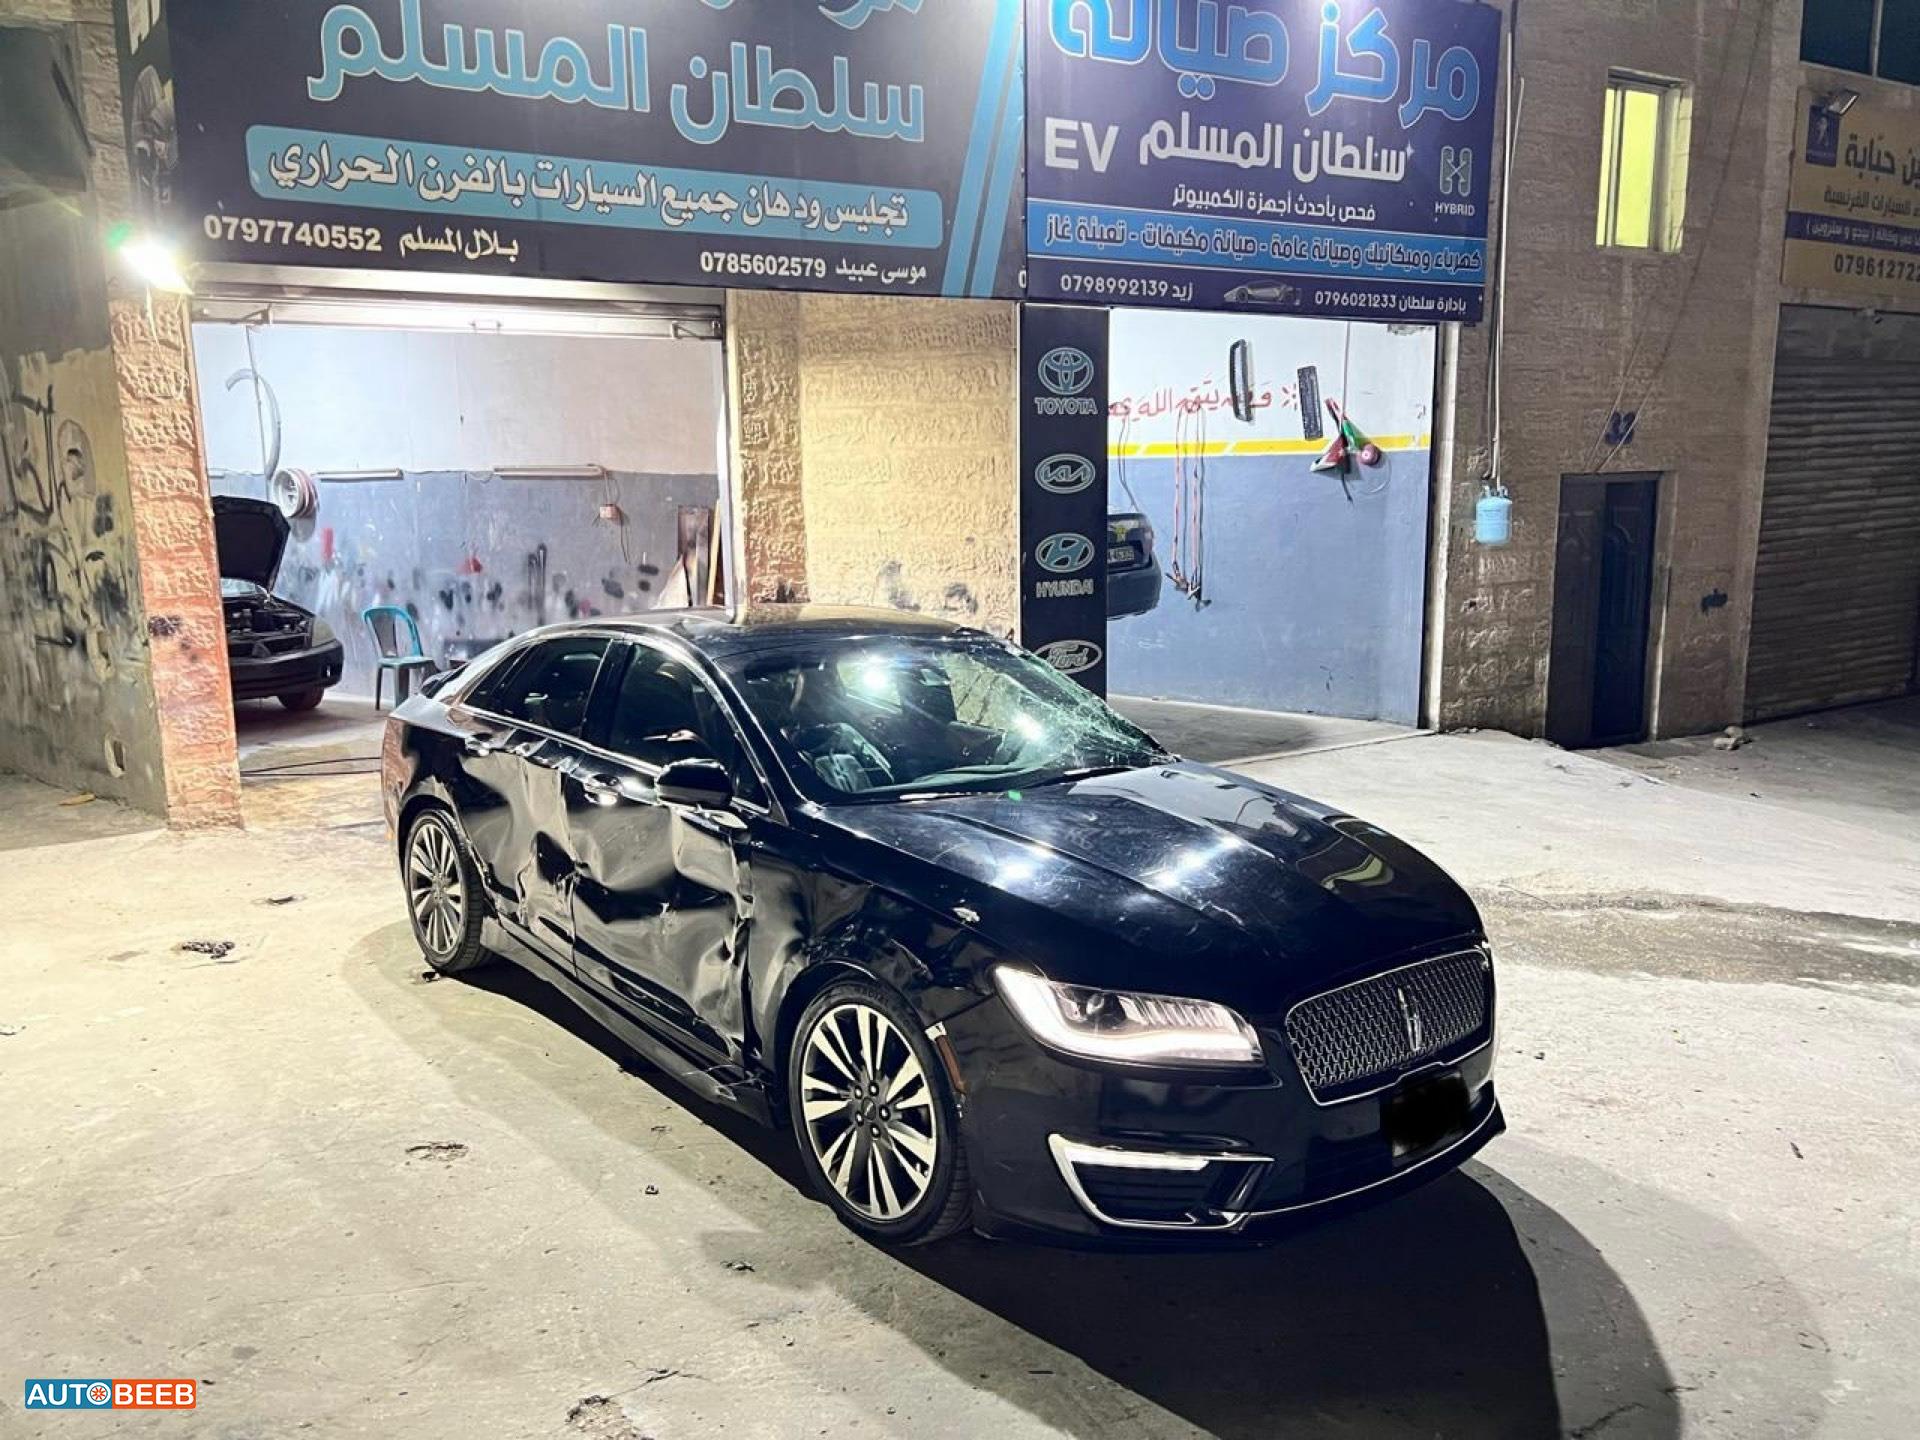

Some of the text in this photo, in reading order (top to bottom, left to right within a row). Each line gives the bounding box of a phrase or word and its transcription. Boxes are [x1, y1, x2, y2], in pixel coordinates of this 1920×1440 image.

[307, 0, 925, 145] سلطان المسلم
[1305, 0, 1480, 129] مركز
[1044, 116, 1119, 172] EV
[1139, 111, 1406, 183] سلطان المسلم
[269, 141, 909, 239] تجليس ودهان جميع السيارات بالفرن الحراري
[1172, 183, 1245, 211] الكمبيوتر
[1338, 204, 1376, 223] فحص
[1434, 201, 1476, 217] HYBRID
[203, 215, 382, 252] 0797740552
[399, 225, 463, 258] المسلم
[1044, 212, 1072, 247] غاز
[1076, 215, 1128, 250] تعبئة
[1141, 221, 1210, 256] مكيفات
[1212, 227, 1258, 261] صيانة
[1271, 233, 1309, 261] عامة
[700, 251, 927, 285] موسى عبيد 0785602579
[1060, 273, 1194, 302] زيد 0798992139
[1314, 289, 1397, 309] 0796021233
[1398, 295, 1436, 313] سلطان
[1035, 397, 1098, 415] TOYOTA
[1137, 386, 1173, 418] الله
[1035, 579, 1093, 599] HYUNDAI
[1048, 639, 1090, 668] Ford
